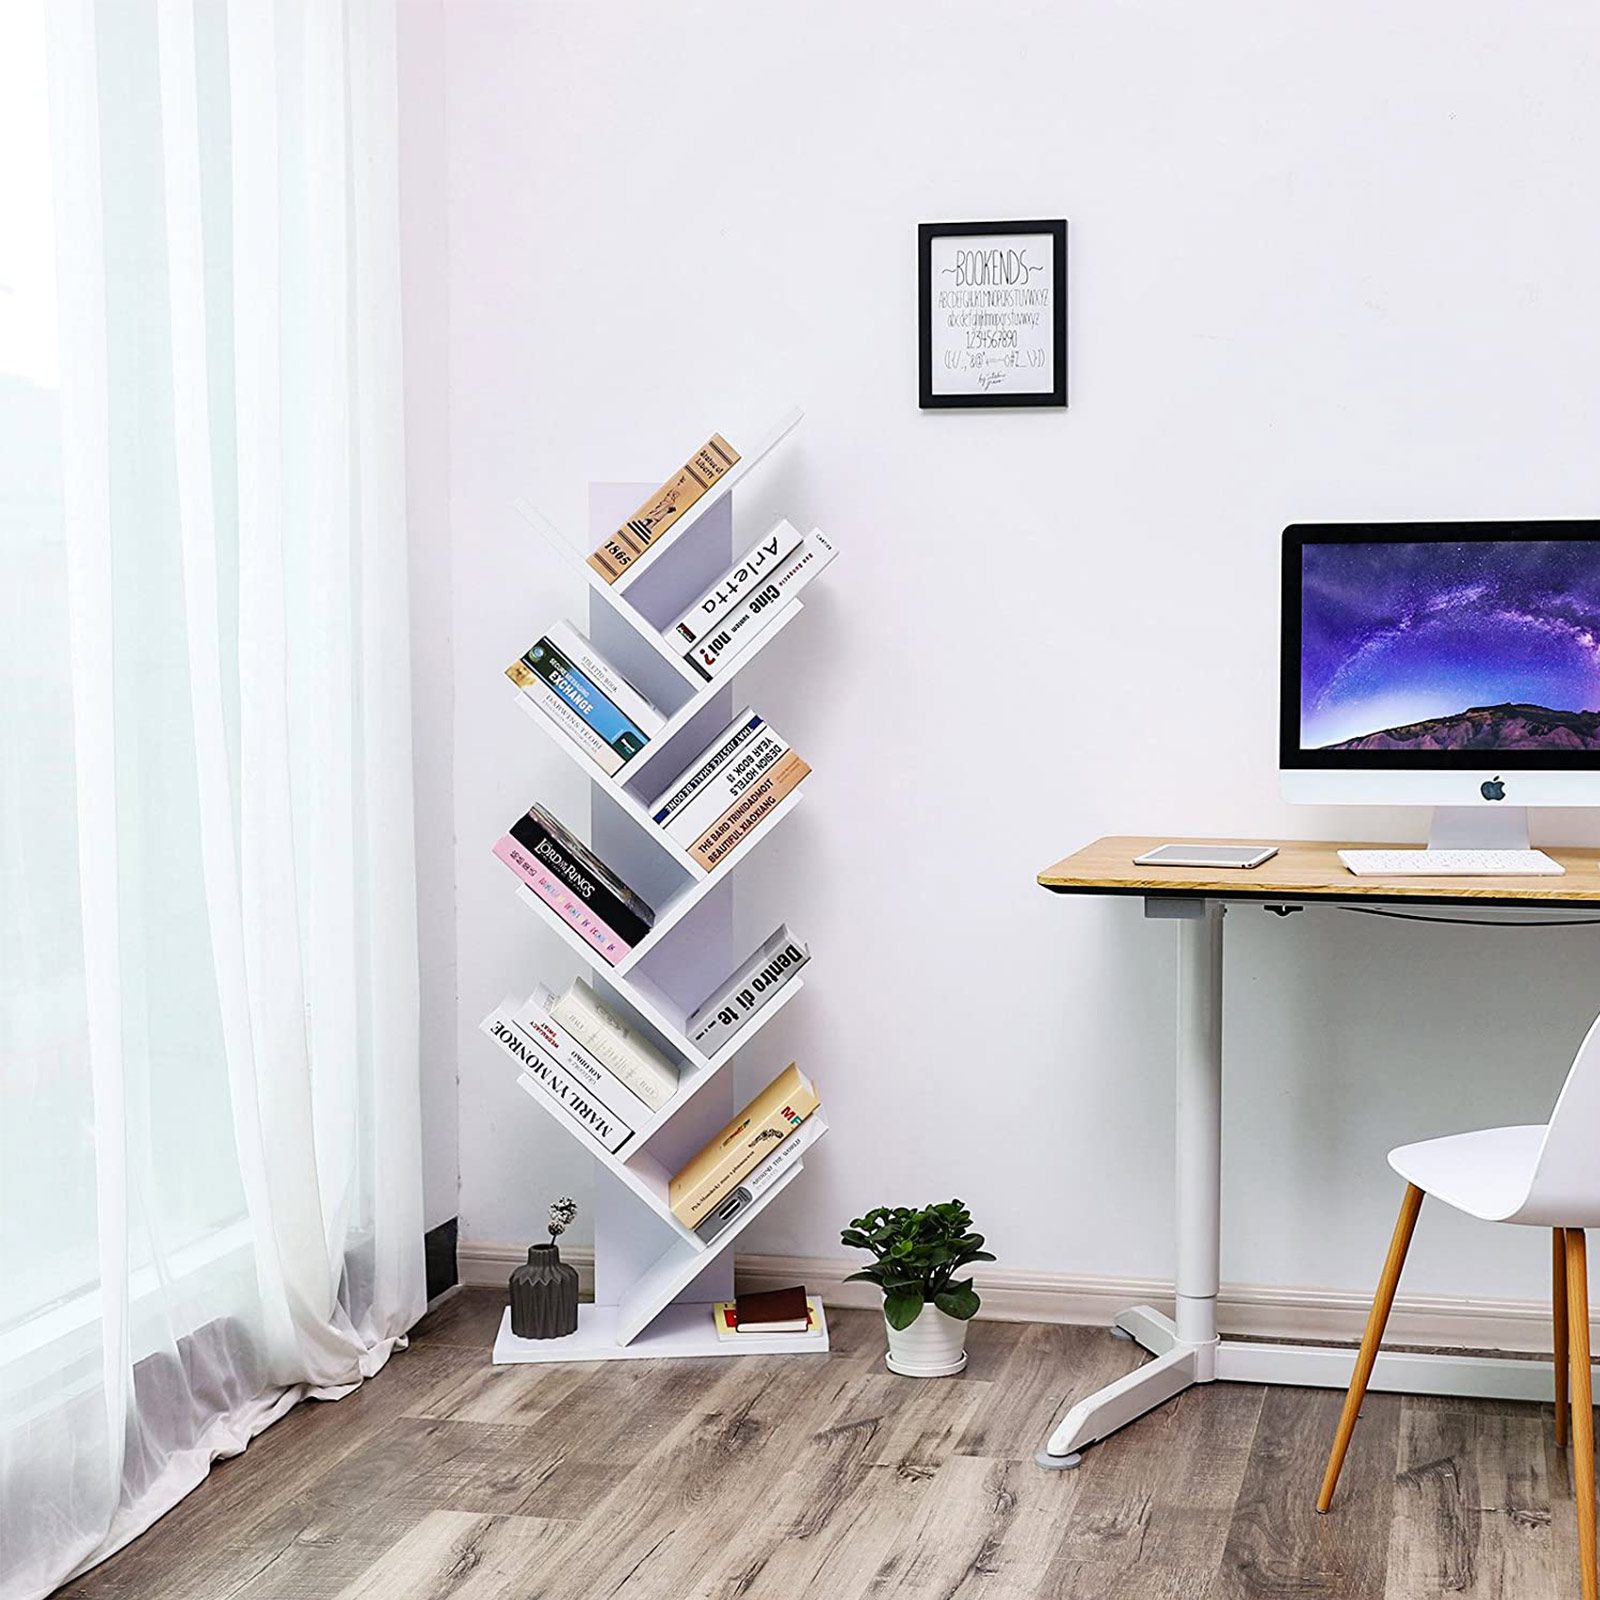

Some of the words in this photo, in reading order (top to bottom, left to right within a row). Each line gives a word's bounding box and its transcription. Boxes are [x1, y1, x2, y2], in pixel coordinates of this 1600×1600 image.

[966, 329, 1017, 349] 1234567890
[604, 540, 632, 566] 1865
[701, 536, 779, 614] Arletta
[749, 584, 781, 613] Cine
[699, 631, 732, 665] noi?
[549, 671, 593, 714] EXCHANGE
[734, 725, 754, 745] THAT
[751, 736, 774, 758] YEAR
[710, 741, 738, 768] JUSTICE
[733, 754, 755, 777] BOOK
[755, 744, 783, 771] DESIGN
[690, 765, 713, 788] SHALL
[729, 767, 759, 797] HOTELS
[665, 792, 686, 813] DONE
[697, 838, 714, 855] THE
[710, 821, 731, 842] BARD
[707, 829, 742, 863] BEAUTIFUL
[738, 796, 777, 833] XIAOXIANG
[533, 837, 565, 868] LORD
[561, 864, 599, 900] RINGS
[752, 944, 803, 992] Dentro
[735, 989, 756, 1011] di
[490, 1020, 552, 1080] MONROE
[547, 1074, 613, 1138] MARILYN
